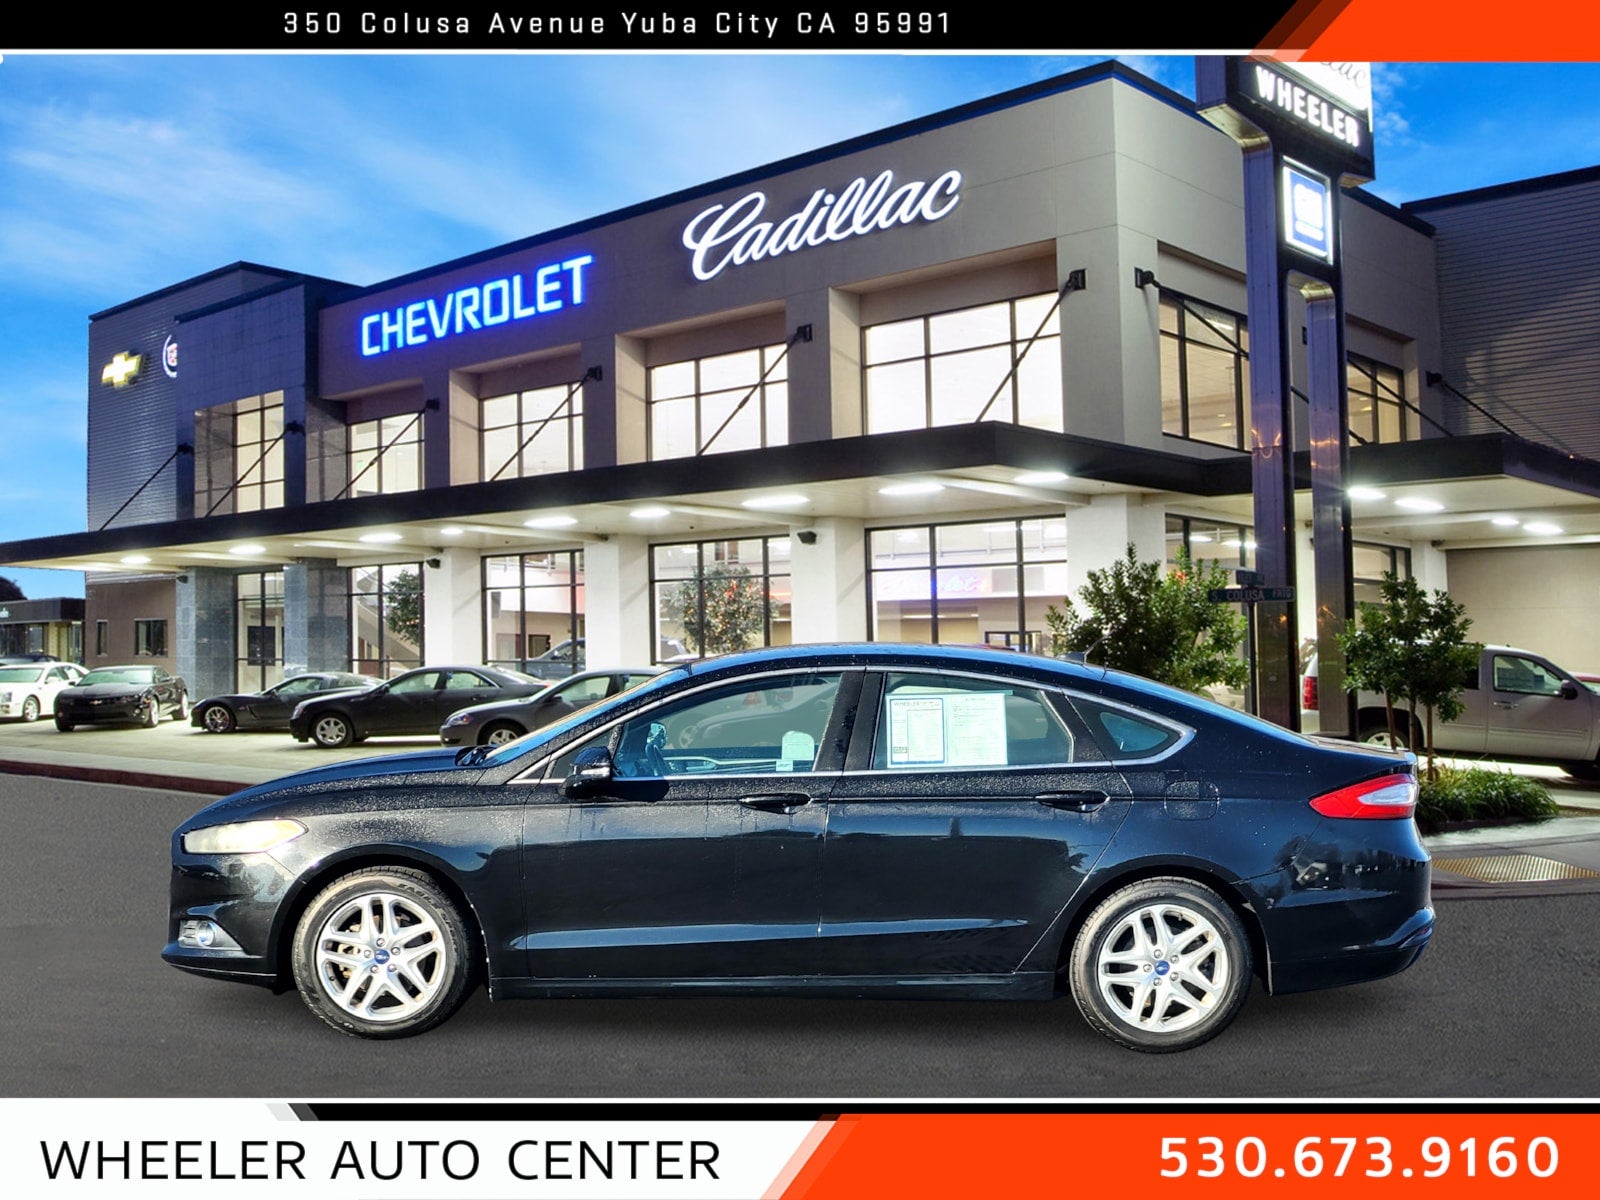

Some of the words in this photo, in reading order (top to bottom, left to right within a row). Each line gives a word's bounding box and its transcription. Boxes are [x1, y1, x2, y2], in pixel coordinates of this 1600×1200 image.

[1256, 65, 1359, 148] WHEELER
[682, 169, 962, 281] Cadillac
[361, 255, 593, 357] CHEVROLET
[1226, 589, 1264, 600] COLUSA
